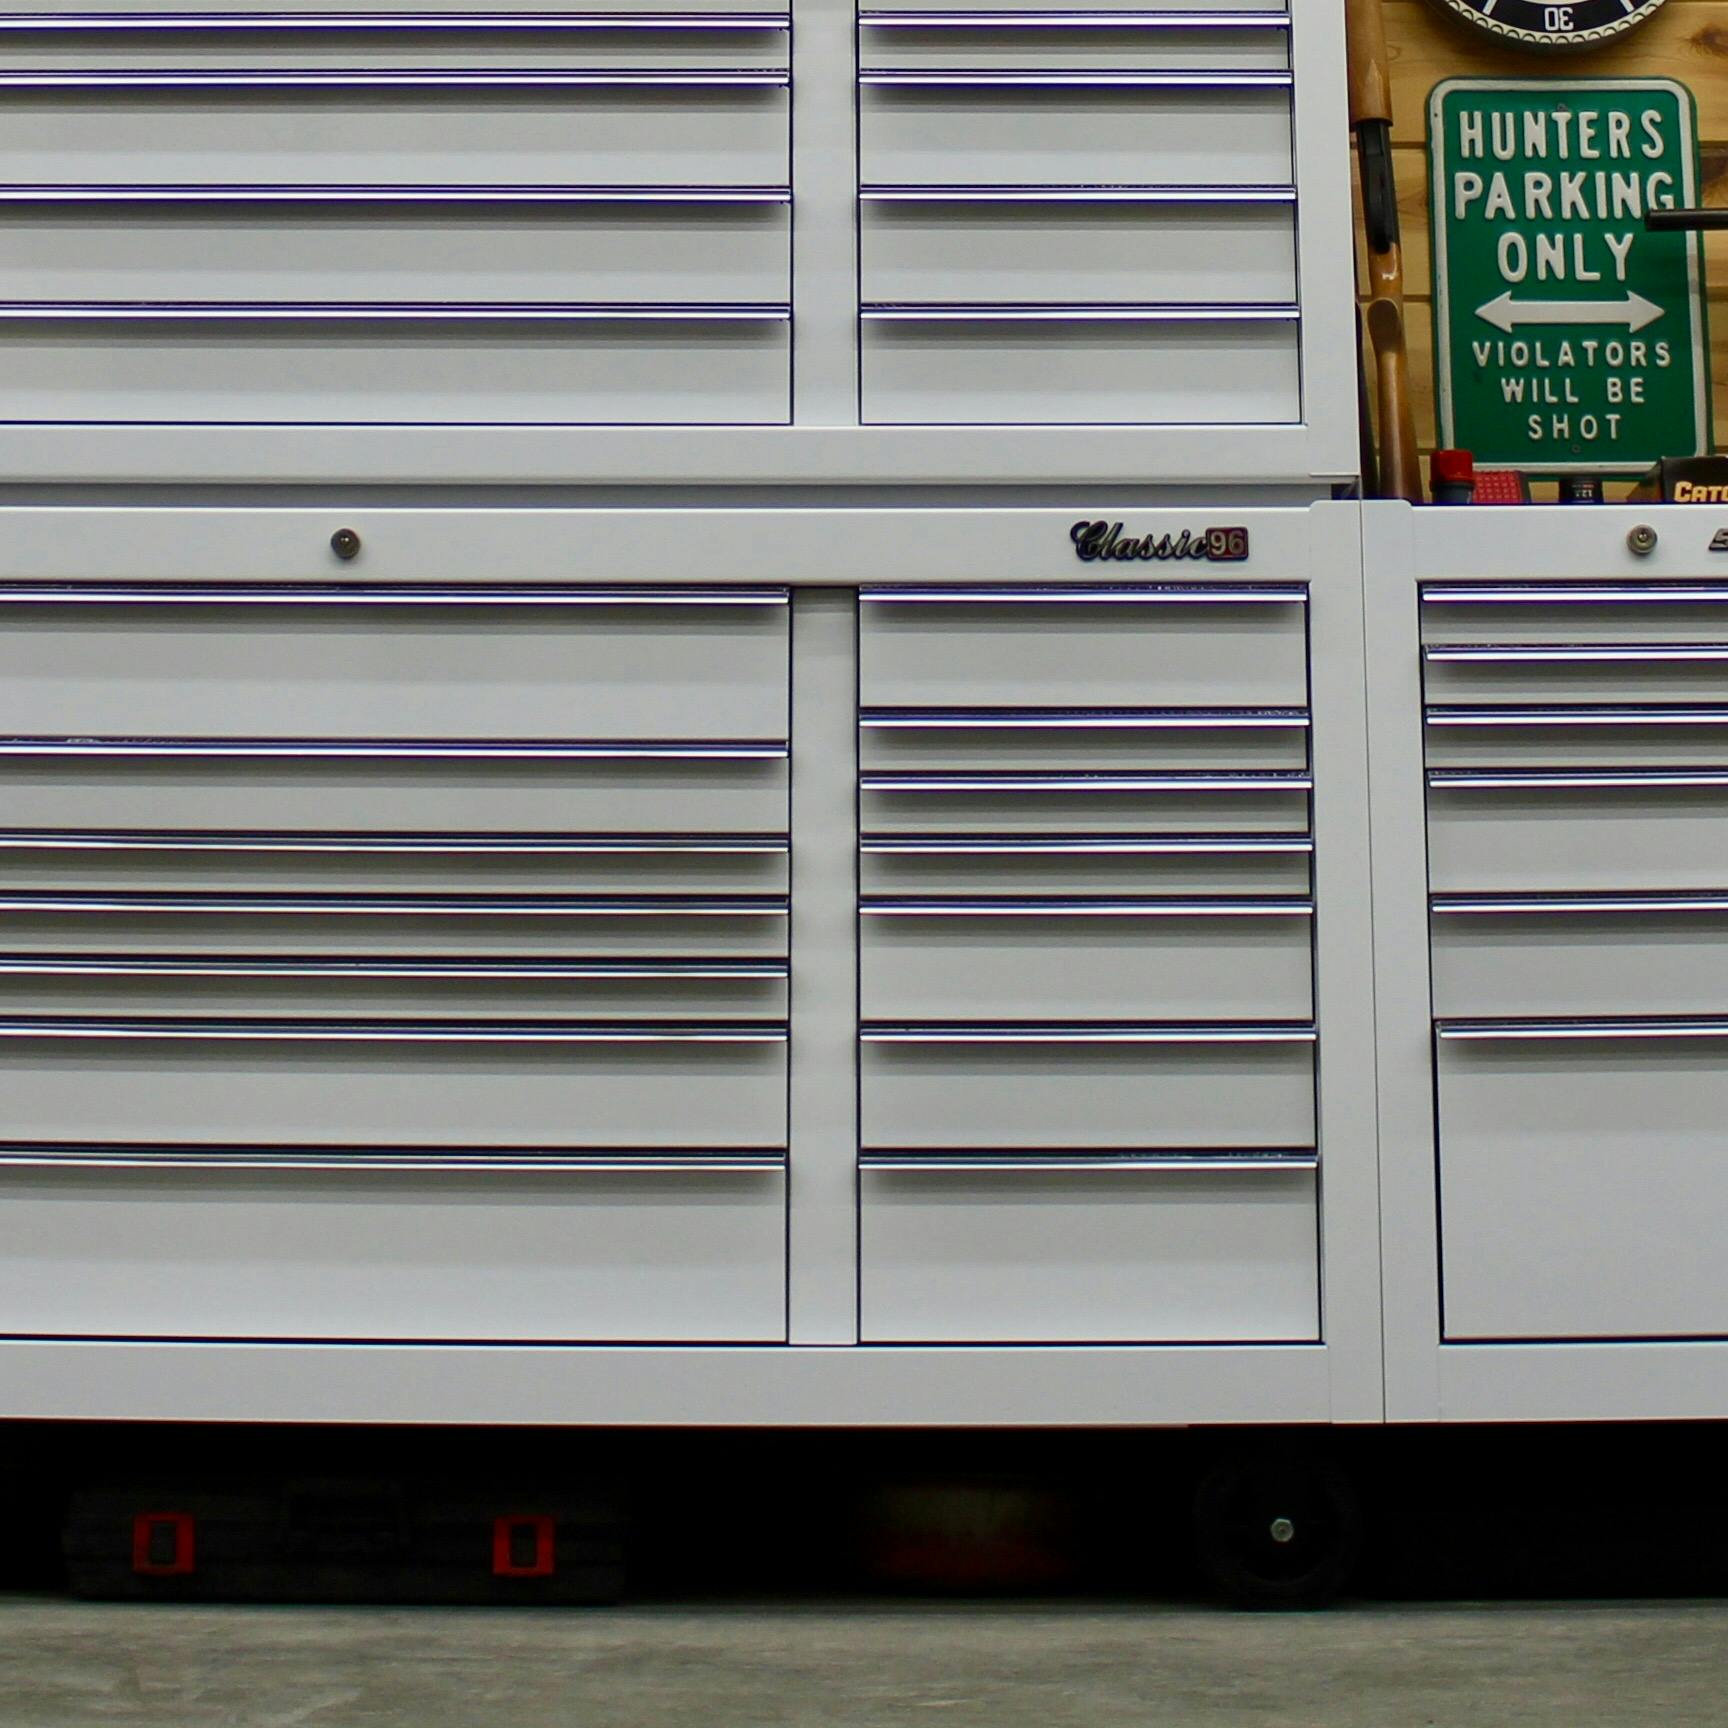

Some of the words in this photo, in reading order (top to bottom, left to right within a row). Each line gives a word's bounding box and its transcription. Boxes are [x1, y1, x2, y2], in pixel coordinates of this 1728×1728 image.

[1544, 7, 1574, 31] 30
[1459, 110, 1665, 160] HUNTERS
[1454, 171, 1675, 221] PARKING
[1497, 232, 1634, 283] ONLY
[1472, 341, 1672, 369] VIOLATORS
[1500, 377, 1580, 405] WILL
[1607, 377, 1646, 404] BE
[1528, 414, 1622, 441] SHOT
[1070, 520, 1209, 562] Classic
[1210, 531, 1246, 556] 96
